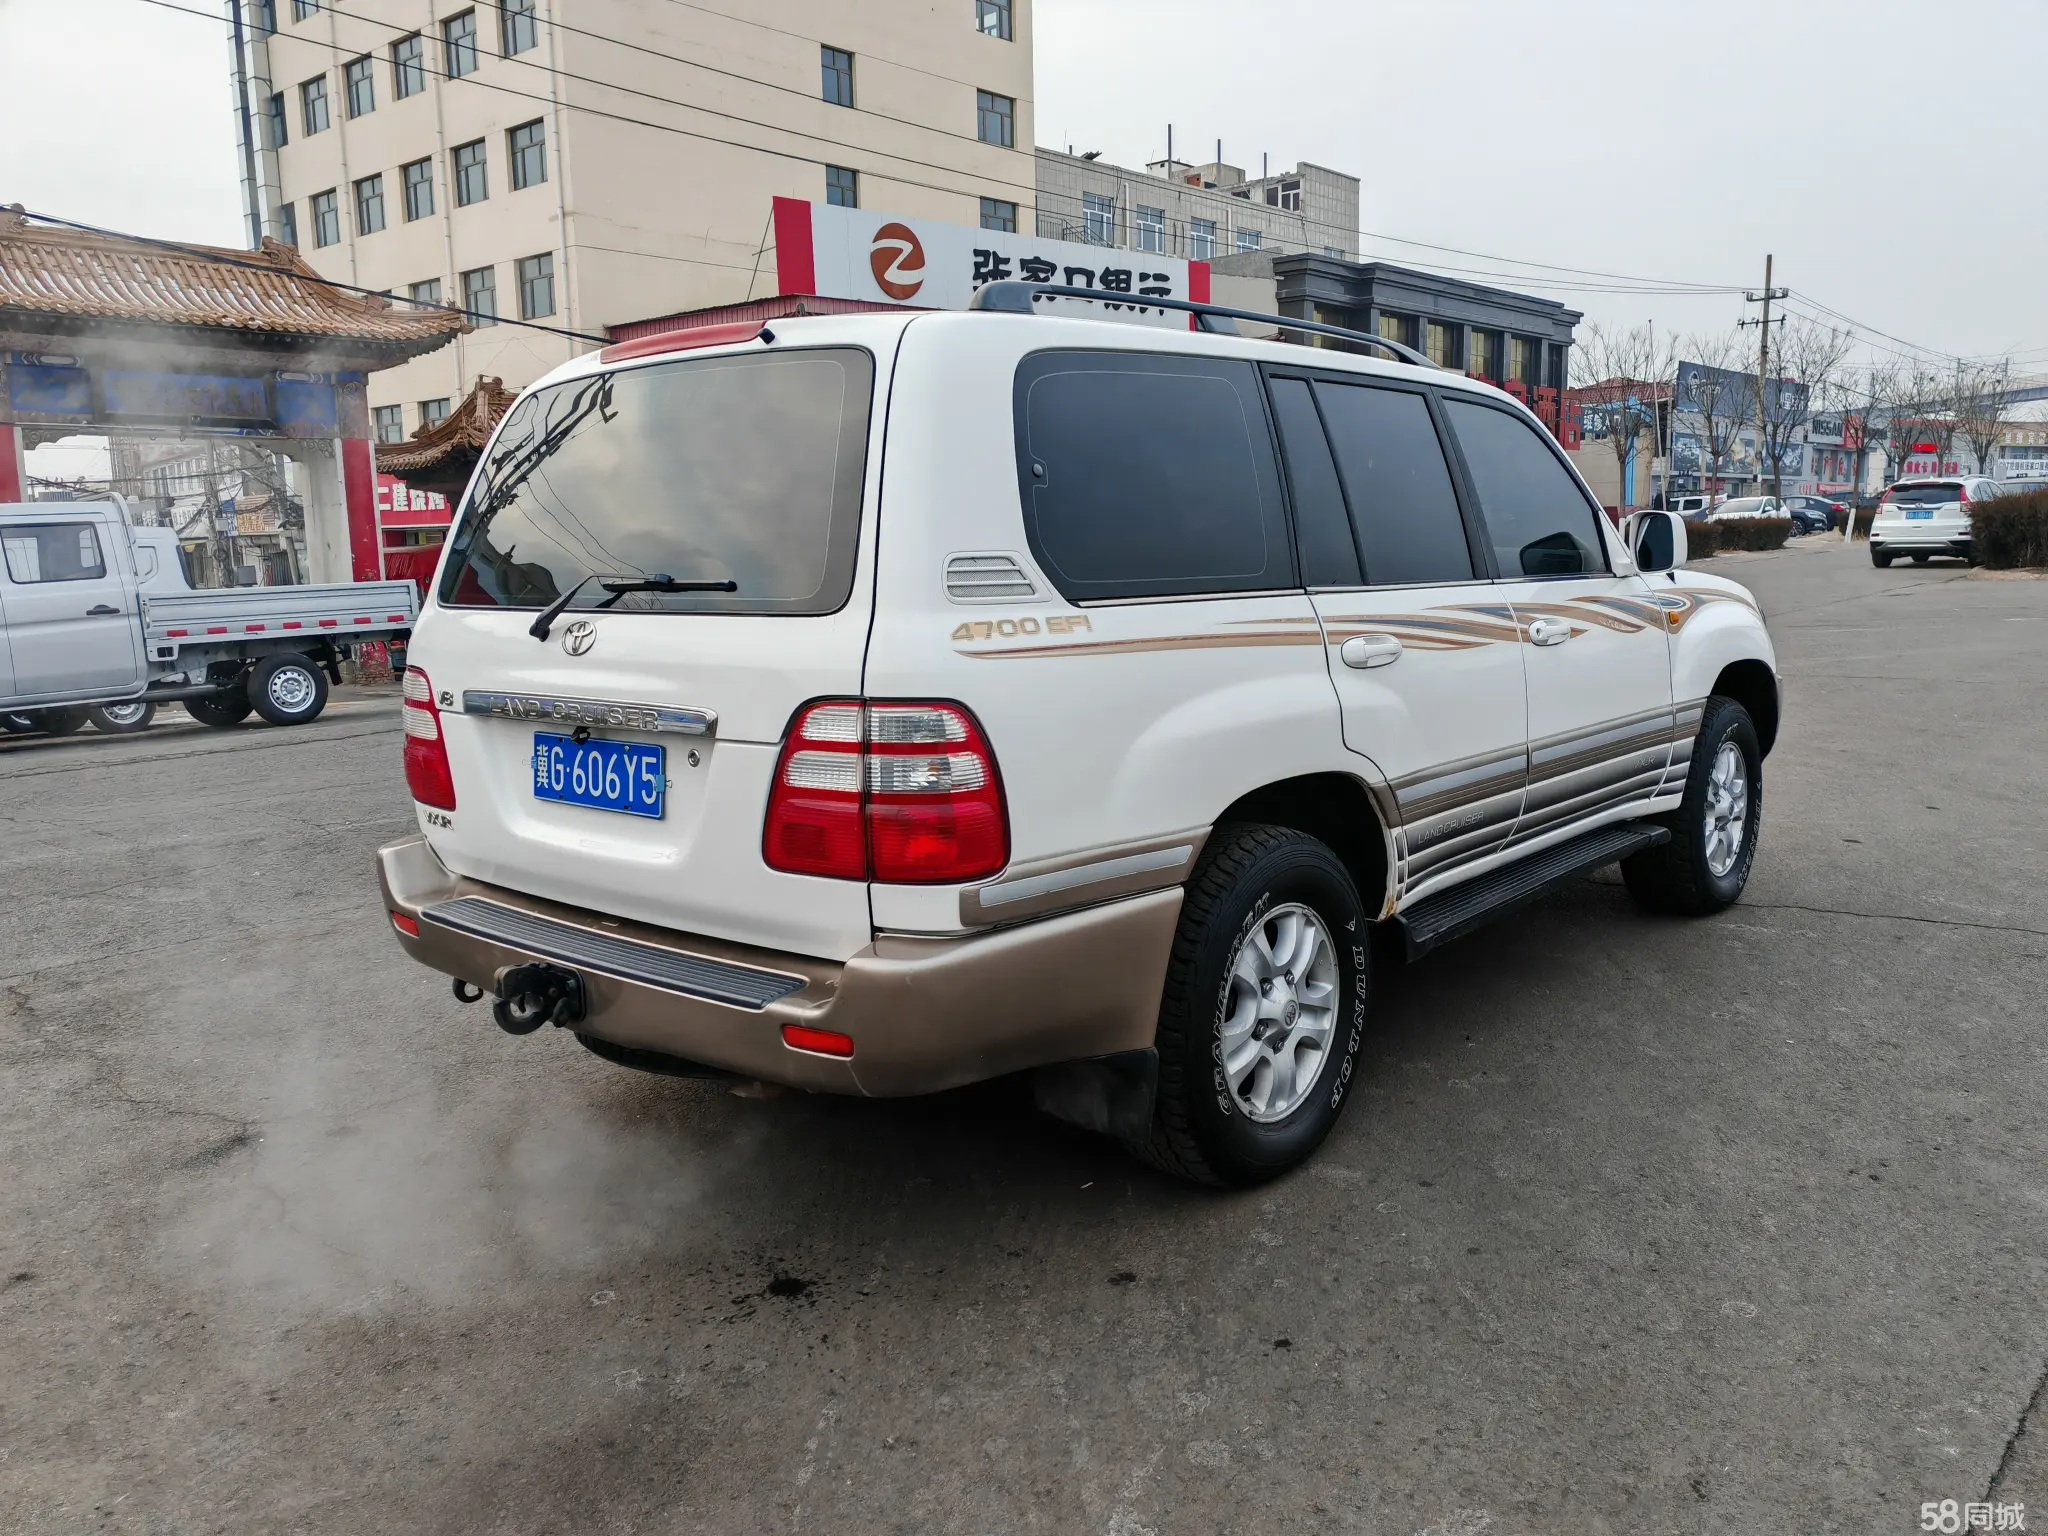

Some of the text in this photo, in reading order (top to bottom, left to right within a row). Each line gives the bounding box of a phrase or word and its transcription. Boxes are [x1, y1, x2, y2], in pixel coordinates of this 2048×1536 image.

[973, 248, 1172, 317] 张家口银行
[1812, 418, 1844, 438] NISSAN
[950, 616, 1041, 642] 4700
[436, 689, 454, 707] V8
[489, 696, 660, 730] LAND CRUISER
[422, 808, 455, 831] VXR
[1331, 945, 1366, 1109] DUNLOP
